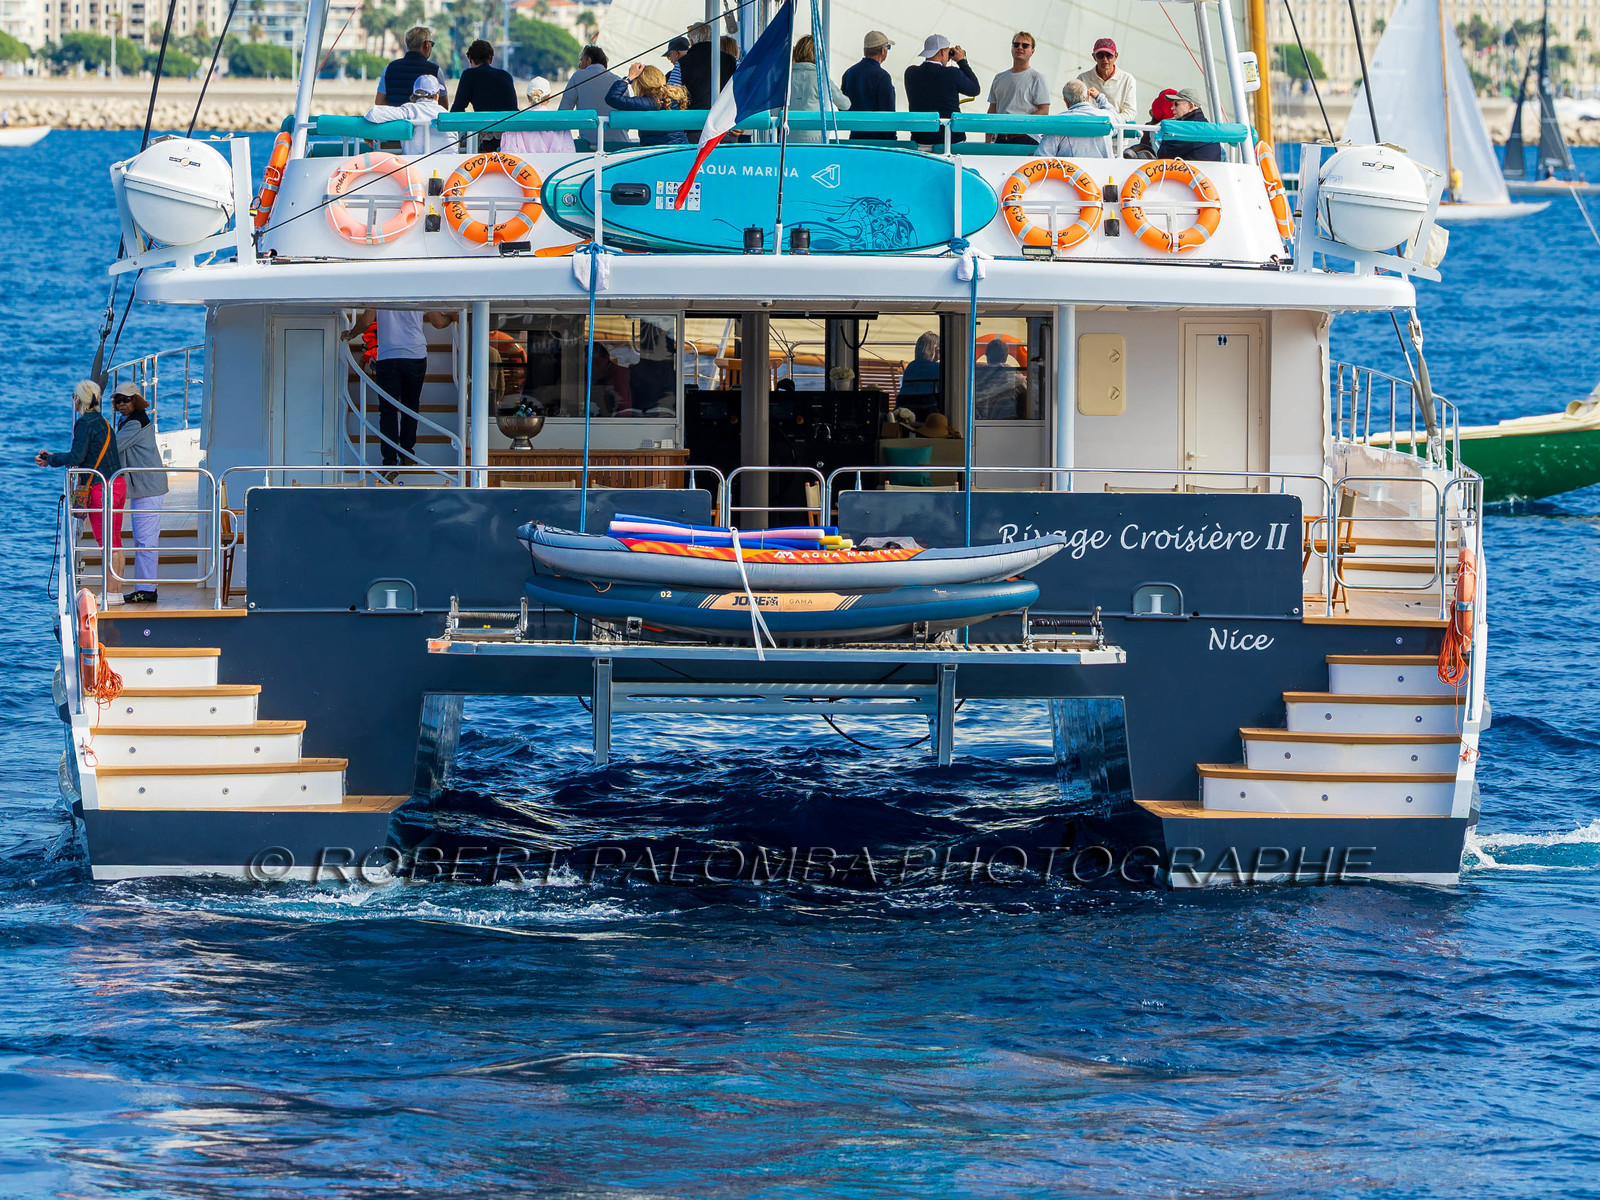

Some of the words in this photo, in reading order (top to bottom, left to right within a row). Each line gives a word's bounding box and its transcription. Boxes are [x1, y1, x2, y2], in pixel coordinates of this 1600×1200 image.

[697, 164, 737, 175] AQUA
[1120, 522, 1262, 552] Croisière
[1265, 523, 1290, 550] II
[847, 549, 902, 557] MARINA
[1208, 627, 1275, 651] Nice
